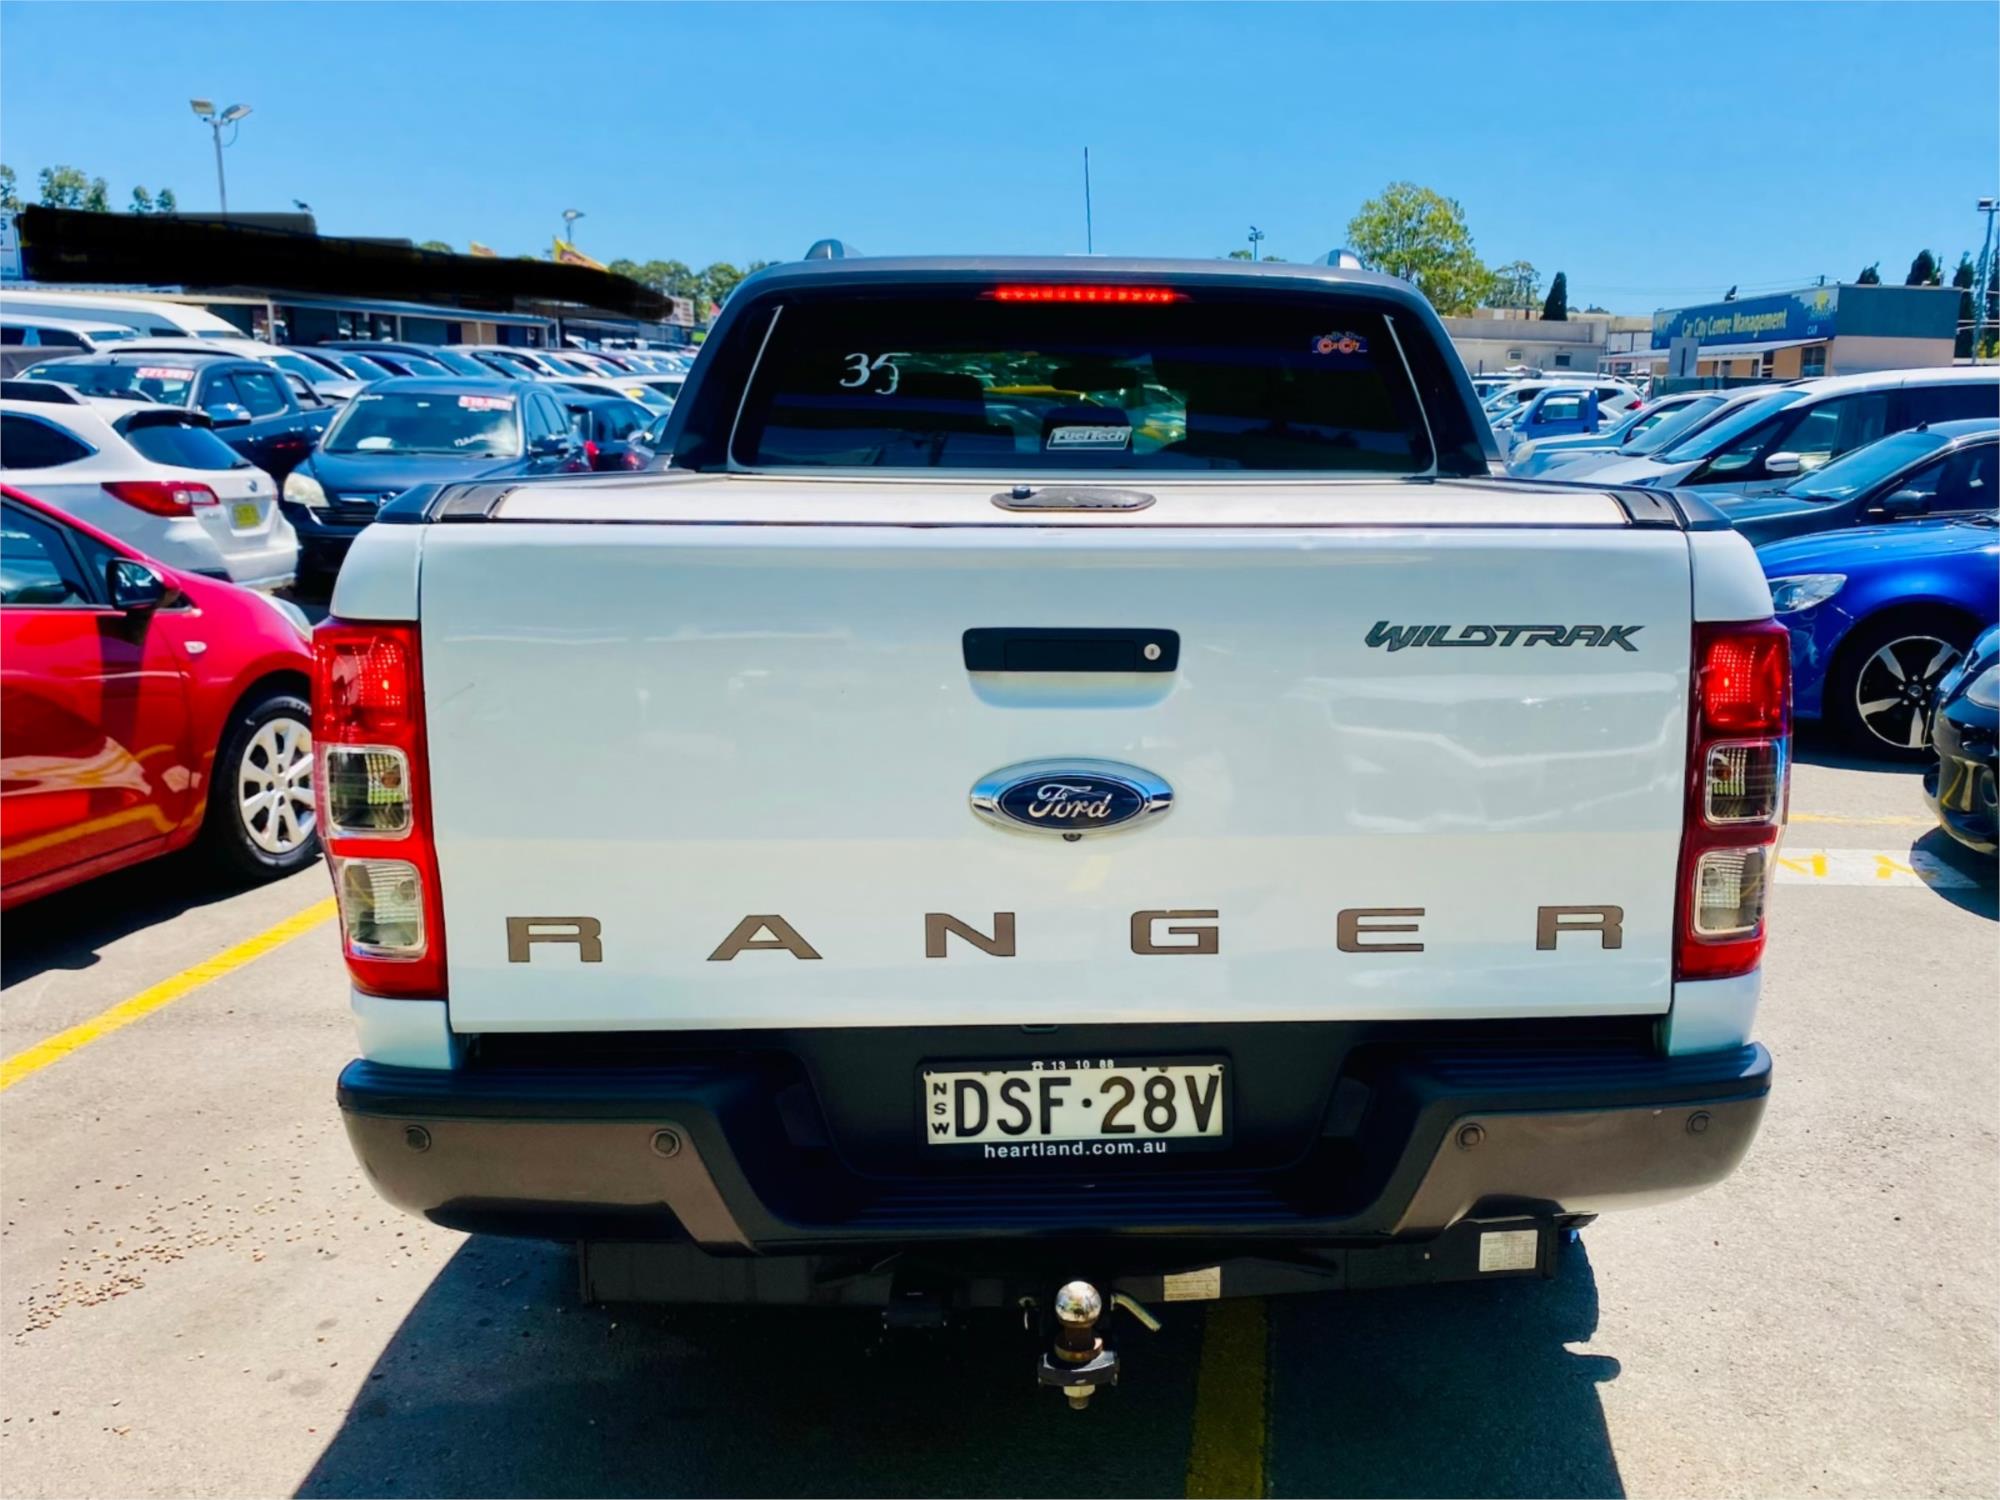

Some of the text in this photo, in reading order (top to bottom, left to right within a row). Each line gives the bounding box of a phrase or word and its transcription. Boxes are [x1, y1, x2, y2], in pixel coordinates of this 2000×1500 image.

[1682, 308, 1787, 342] Car City Centre Management
[839, 352, 911, 395] 35
[1364, 620, 1646, 652] WILDTRAK
[1027, 783, 1113, 819] Ford
[505, 904, 1624, 964] RANGER
[1051, 1060, 1066, 1070] 13
[1075, 1059, 1090, 1069] 10
[984, 1141, 1167, 1159] heartland.com.au
